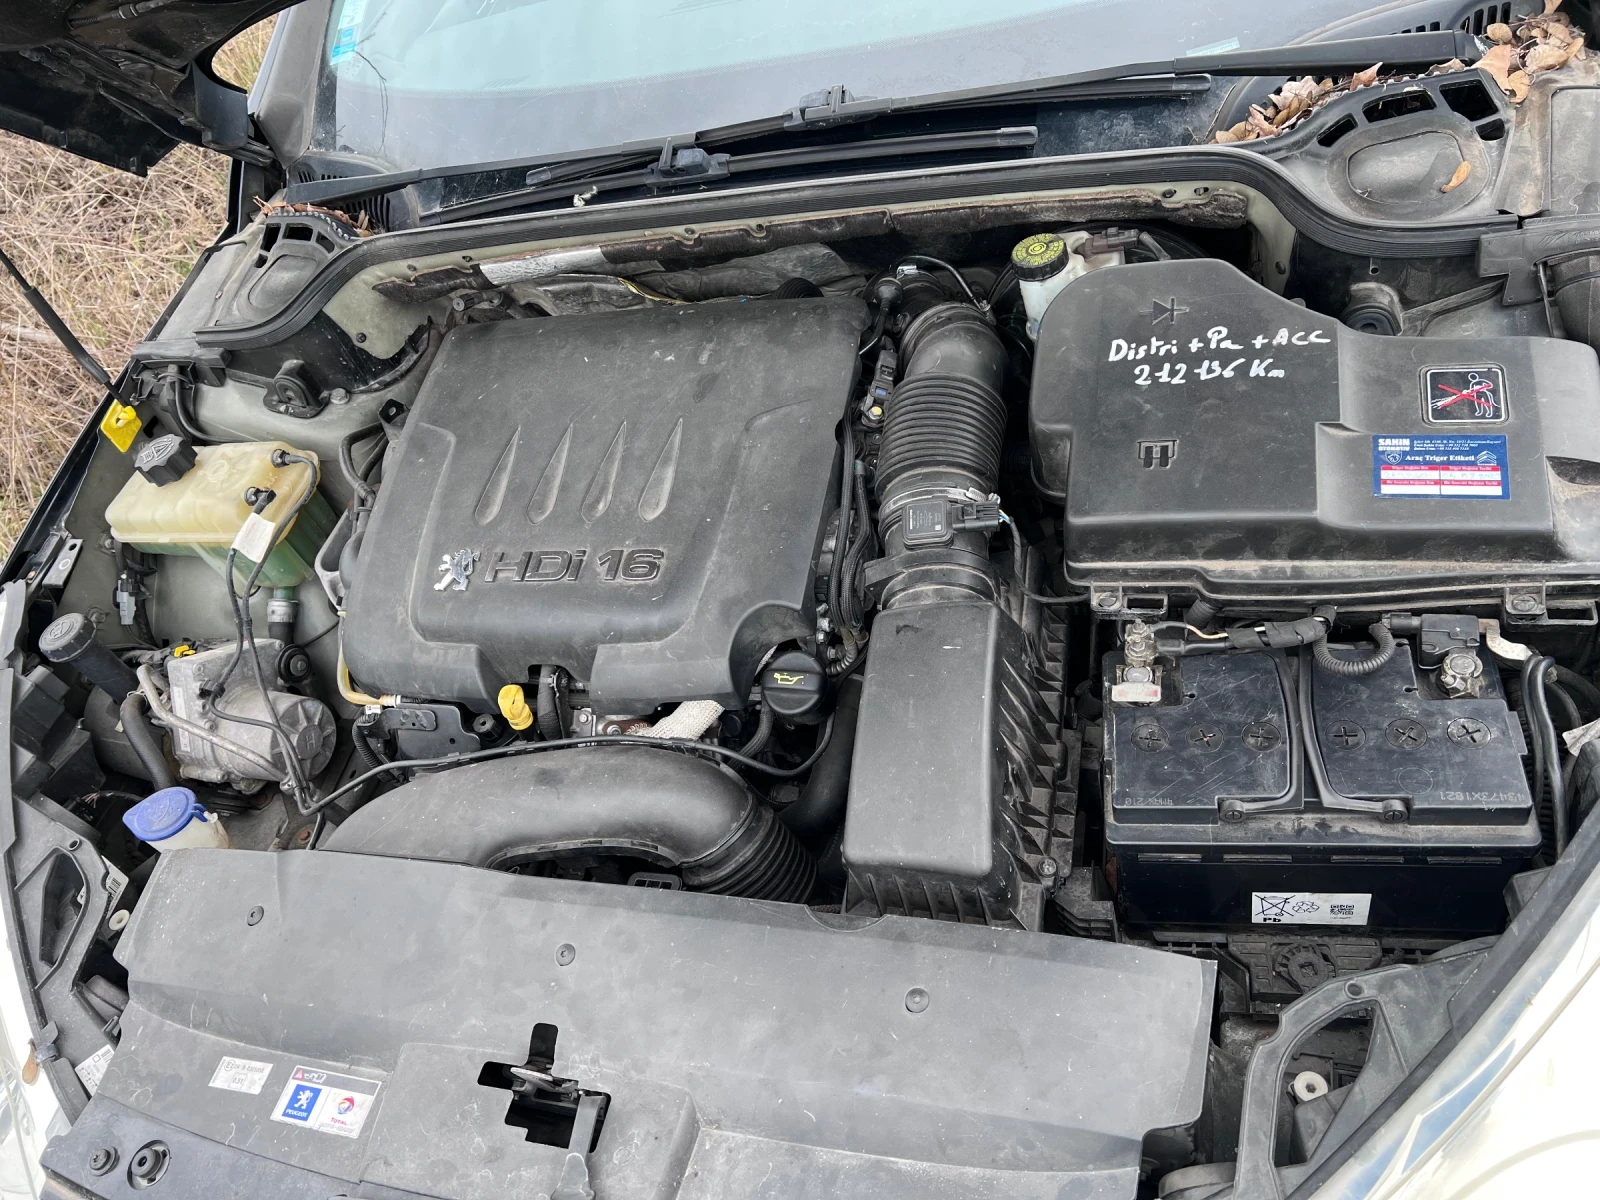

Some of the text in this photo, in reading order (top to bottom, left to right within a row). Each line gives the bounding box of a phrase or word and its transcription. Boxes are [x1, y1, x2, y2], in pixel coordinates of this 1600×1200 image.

[1108, 336, 1178, 362] Distri
[1134, 362, 1188, 386] 212
[1405, 454, 1424, 462] Araç
[1424, 454, 1448, 463] Triger
[484, 548, 666, 583] HDi 16
[285, 1108, 309, 1118] PEUGEOT
[330, 1117, 348, 1126] TOTAL
